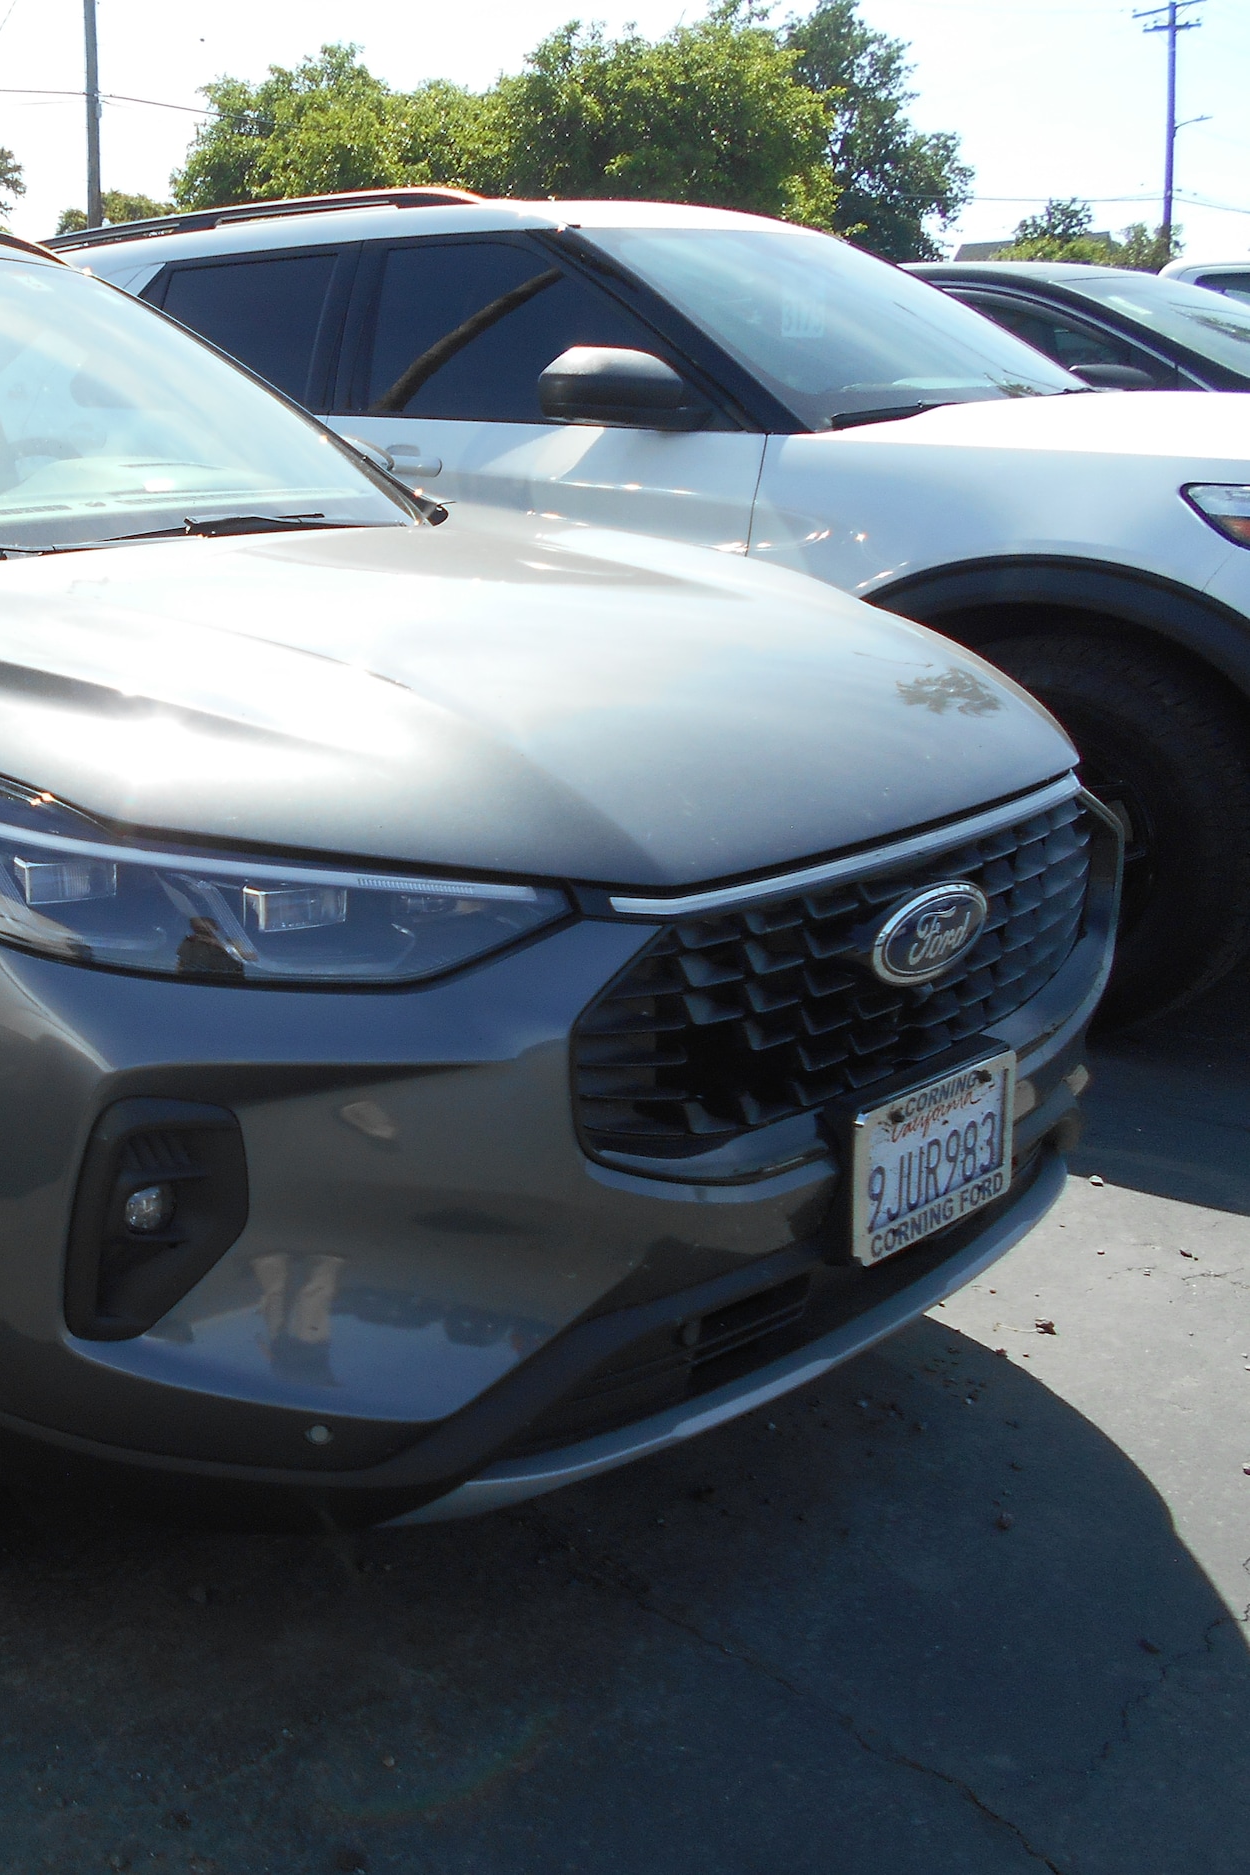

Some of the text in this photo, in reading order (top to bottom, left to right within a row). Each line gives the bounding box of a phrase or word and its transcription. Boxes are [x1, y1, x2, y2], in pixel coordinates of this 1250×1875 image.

[908, 905, 970, 966] Ford
[905, 1070, 980, 1115] CORNING
[868, 1111, 997, 1234] 9JUR983
[871, 1172, 1004, 1258] CORNING FORD
